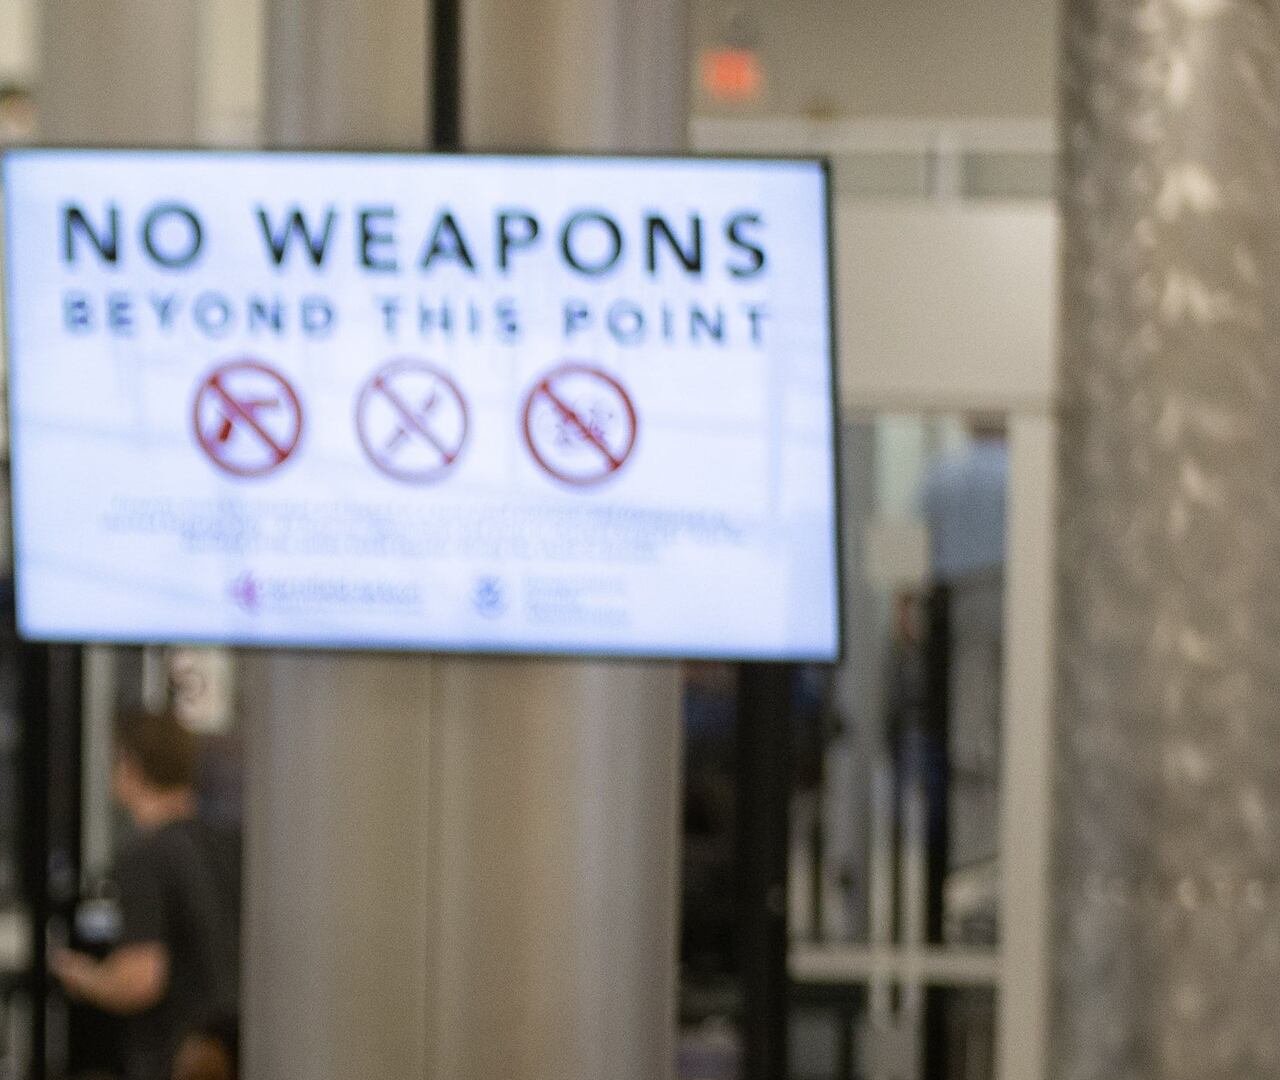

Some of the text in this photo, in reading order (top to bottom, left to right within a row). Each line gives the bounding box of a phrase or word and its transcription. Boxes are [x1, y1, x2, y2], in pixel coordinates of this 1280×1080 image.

[61, 203, 770, 280] NO WEAPONS
[64, 294, 772, 346] BEYOND THIS POINT
